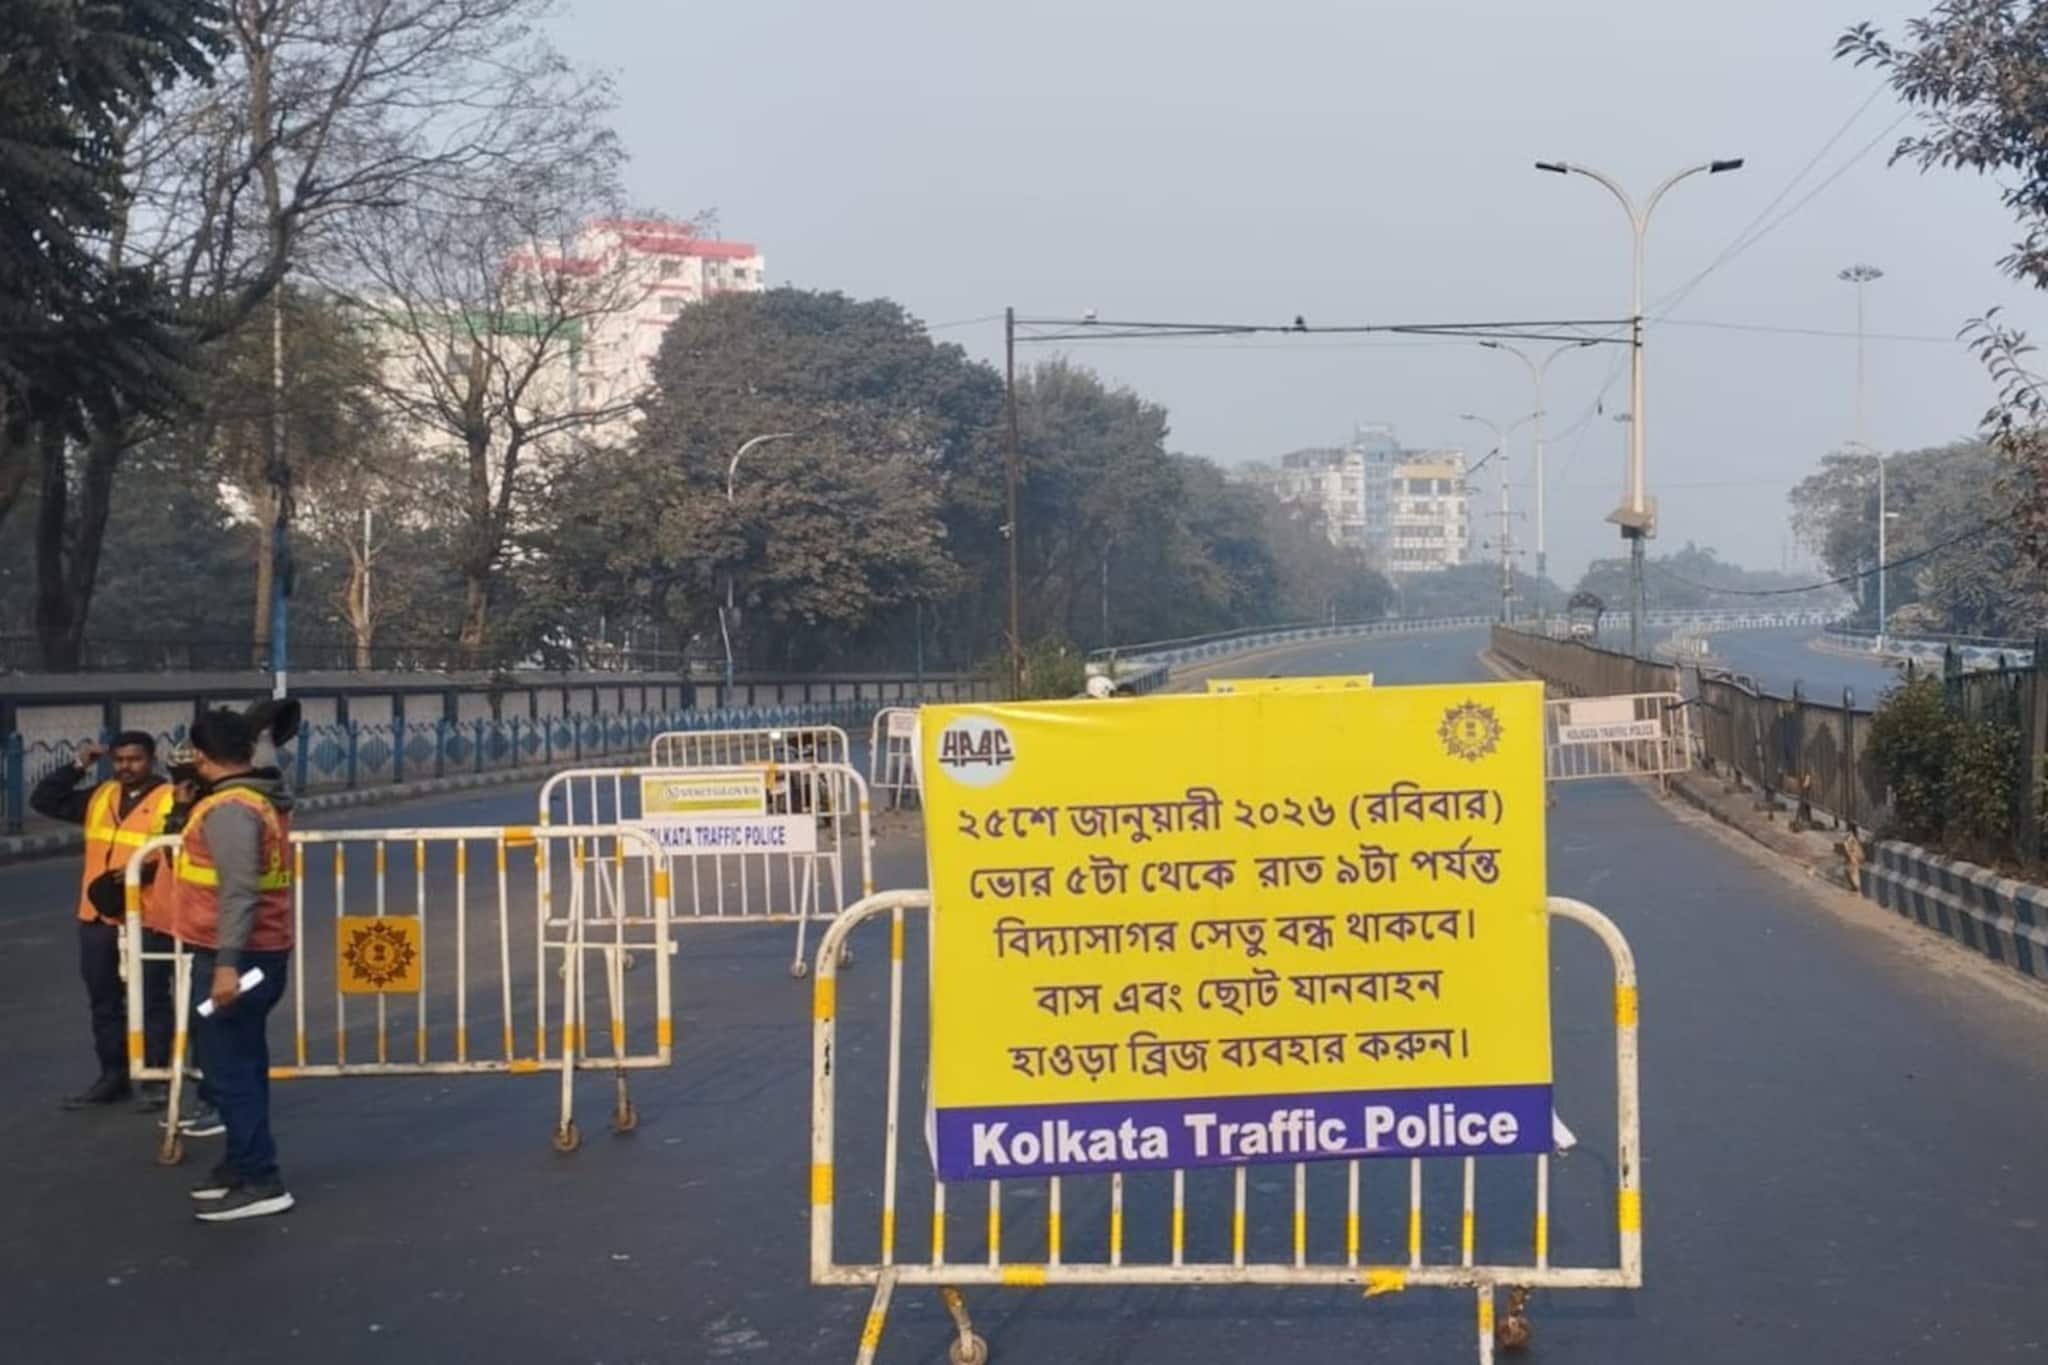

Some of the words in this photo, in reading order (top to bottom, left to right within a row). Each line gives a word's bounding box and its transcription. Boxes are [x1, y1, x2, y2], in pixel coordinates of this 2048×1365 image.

[645, 826, 692, 848] LKATA
[695, 825, 742, 847] TRAFFIC
[745, 825, 786, 846] POLICE
[959, 807, 1059, 838] ২৫শে
[1067, 787, 1223, 843] জানুয়ারী
[1235, 797, 1335, 828] ২০২৬
[1350, 781, 1502, 830] (রবিবার)
[971, 867, 1054, 899] ভোর
[1066, 855, 1128, 894] ৫টা
[1142, 860, 1236, 892] থেকে
[1254, 856, 1325, 887] রাত
[1337, 844, 1399, 884] ৯টা
[1410, 837, 1501, 884] পর্যন্ত
[993, 917, 1178, 957] বিদ্যাসাগর
[1191, 919, 1267, 957] সেতু
[1274, 915, 1336, 950] বন্ধ
[1346, 910, 1474, 943] থাকবে।
[1034, 985, 1102, 1016] বাস
[1114, 982, 1182, 1013] এবং
[1198, 968, 1281, 1015] ছোট
[1288, 970, 1443, 1005] যানবাহন
[1008, 1043, 1119, 1082] হাওড়া
[1126, 1031, 1210, 1076] ব্রিজ
[1218, 1034, 1347, 1067] ব্যবহার
[1355, 1029, 1468, 1061] করুন।
[972, 1119, 1169, 1167] Kolkata
[1184, 1107, 1347, 1157] Traffic
[1365, 1102, 1519, 1152] Police
